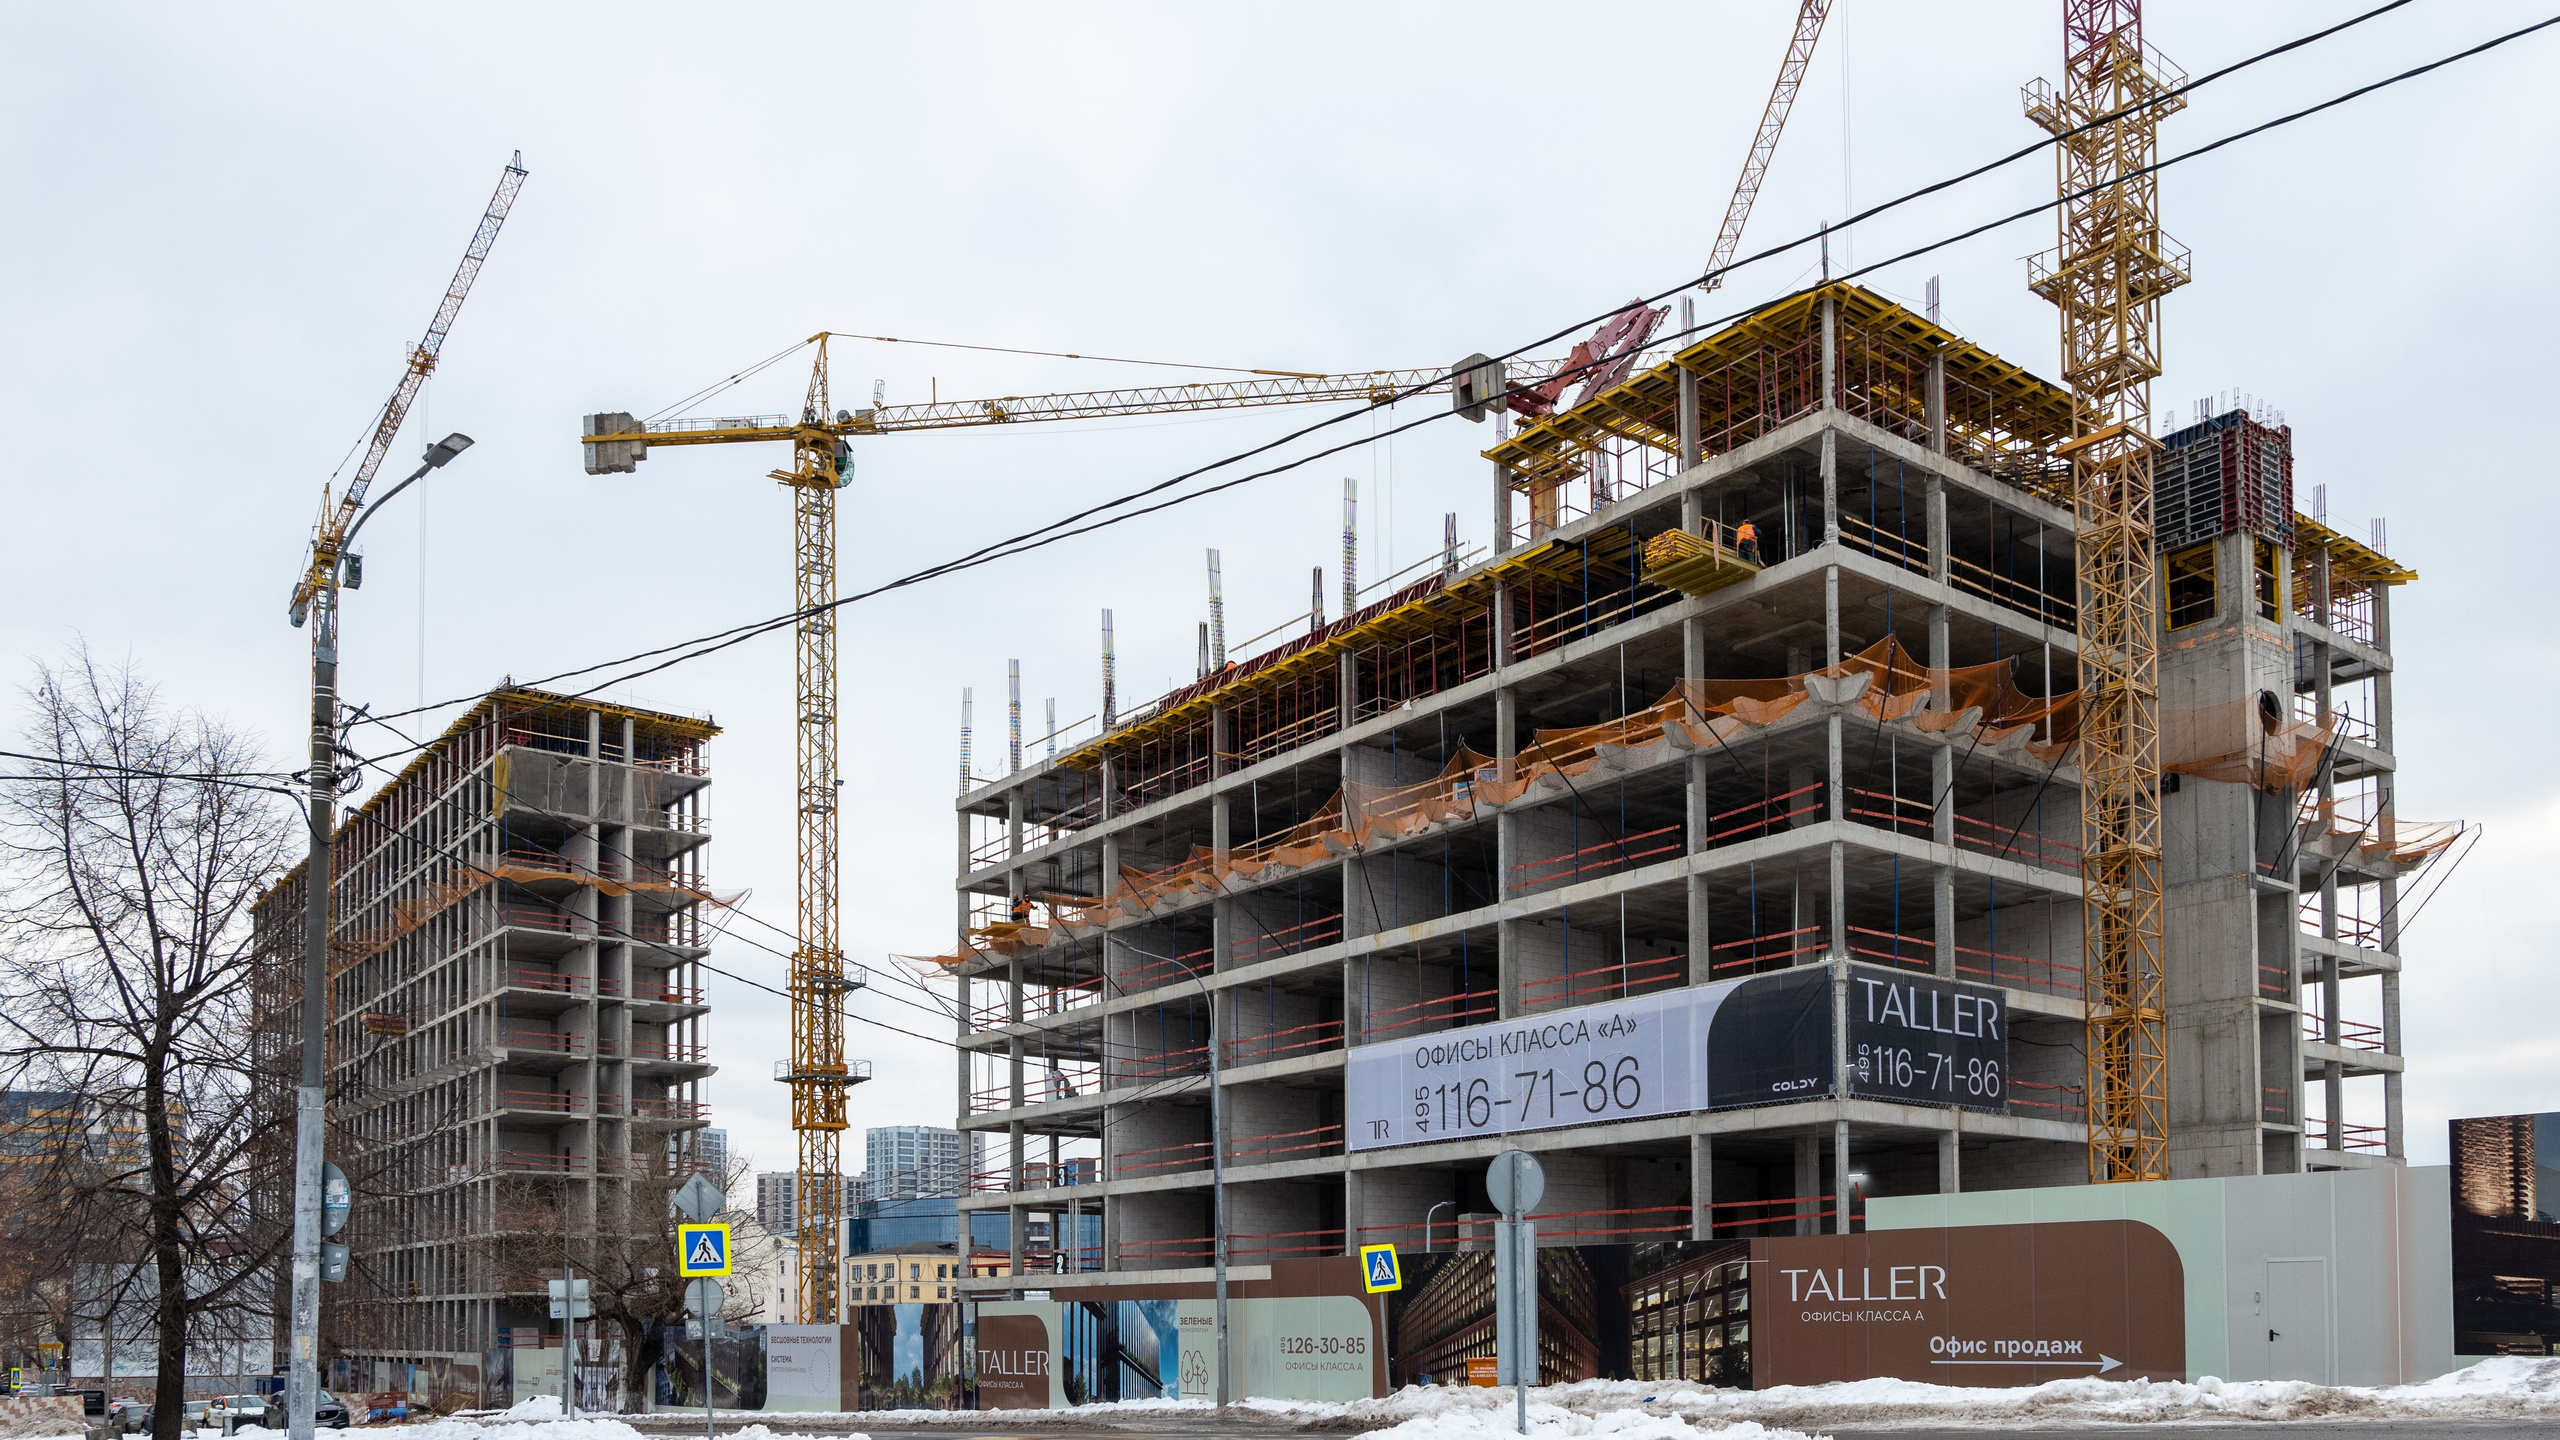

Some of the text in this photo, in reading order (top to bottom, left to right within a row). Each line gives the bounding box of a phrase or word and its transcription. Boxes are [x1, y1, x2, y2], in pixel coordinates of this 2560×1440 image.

[1857, 977, 1999, 1040] TALLER
[1415, 1013, 1637, 1068] ОФИСЫ КЛАССА «А»
[1858, 1043, 1870, 1083] 495
[1873, 1046, 2000, 1098] 116-71-86
[1435, 1056, 1641, 1131] 116-71-86
[1772, 1078, 1818, 1092] COLDY
[1415, 1085, 1430, 1133] 495
[1058, 1167, 1065, 1186] 3
[1056, 1254, 1064, 1274] 2
[1780, 1265, 1947, 1302] TALLER
[1180, 1317, 1213, 1325] ЗЕЛЕНЫЕ
[1801, 1310, 1925, 1322] ОФИСЫ КЛАССА А
[800, 1336, 832, 1344] ТЕХНОЛОГИИ
[1287, 1337, 1366, 1354] 126-30-85
[1929, 1335, 2083, 1358] Офис продаж
[978, 1350, 1049, 1375] TALLER
[1285, 1362, 1364, 1371] ОФИСЫ КЛАССА А
[998, 1381, 1019, 1389] КЛАССА
